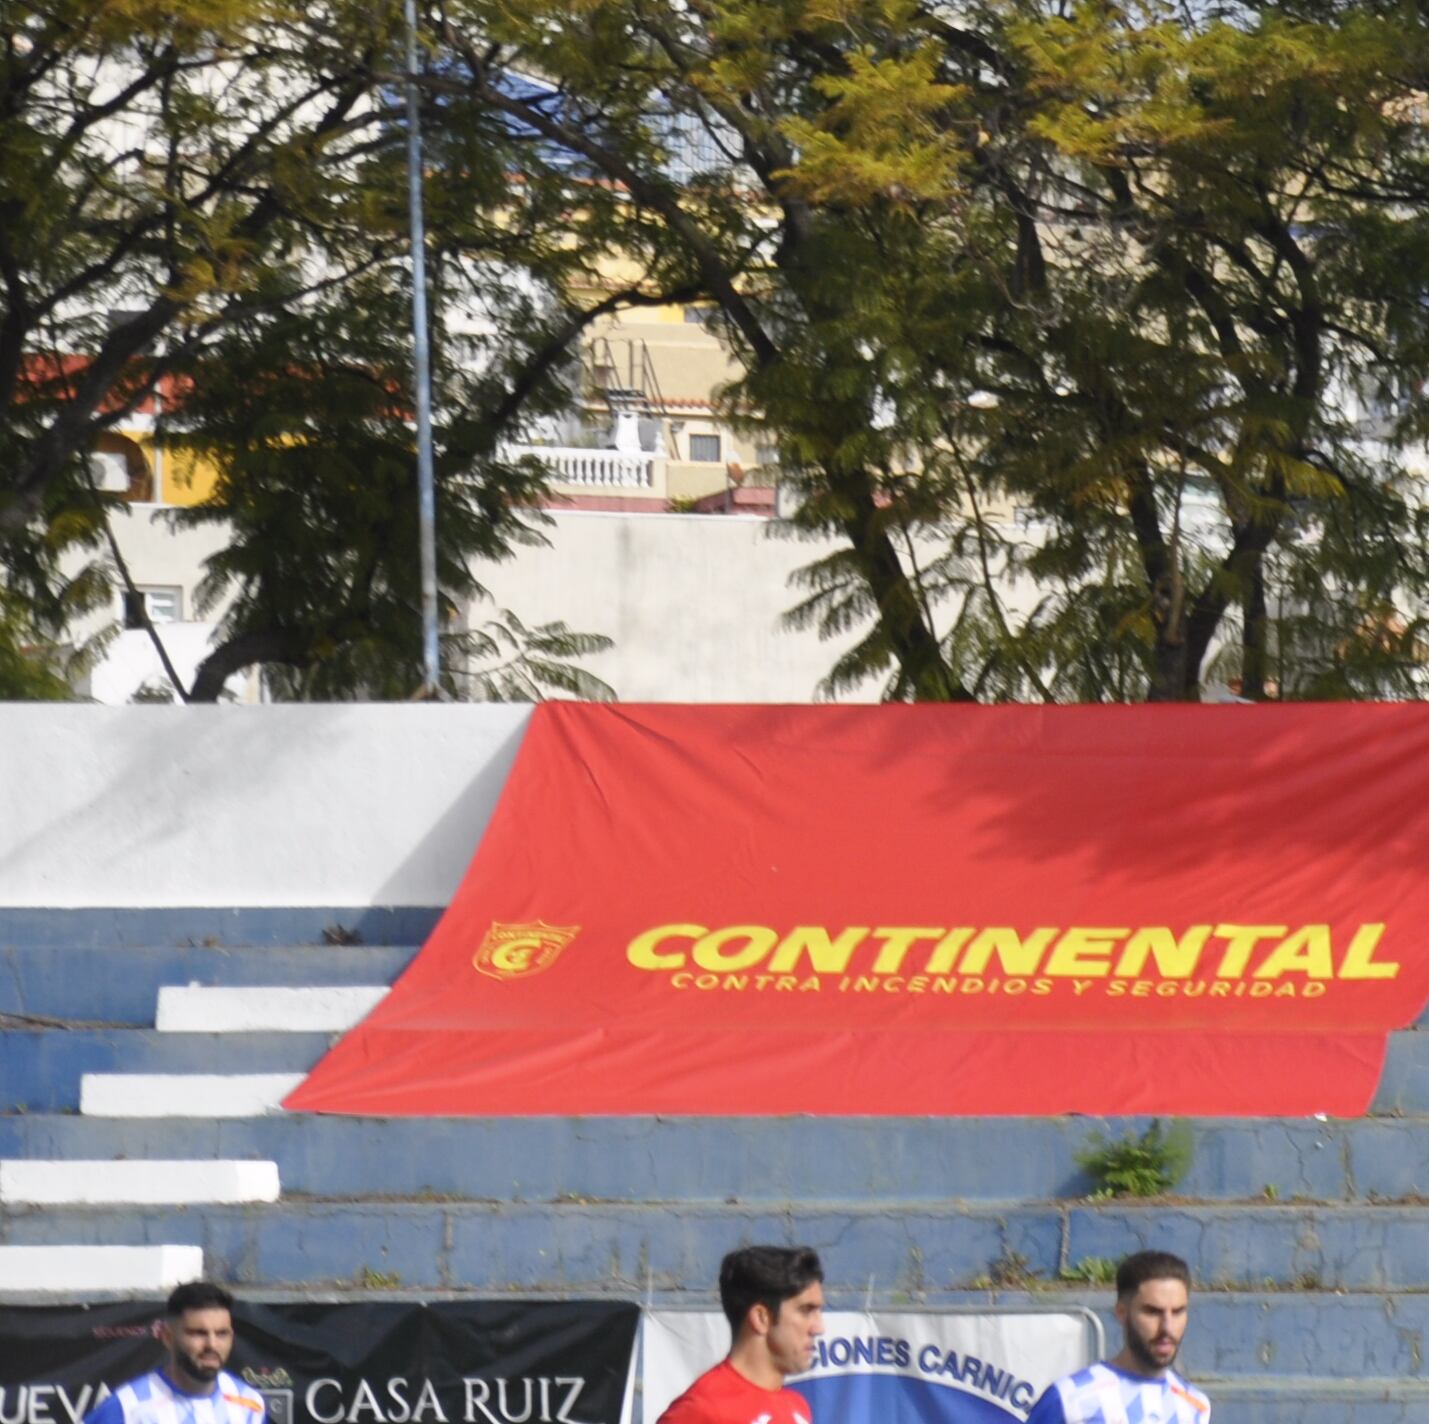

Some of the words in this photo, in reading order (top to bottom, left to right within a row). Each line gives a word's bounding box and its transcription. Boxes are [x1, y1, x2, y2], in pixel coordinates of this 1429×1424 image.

[626, 922, 1400, 980] CONTINENTAL
[671, 972, 821, 993] CONTRA
[838, 975, 1053, 997] INCENDIOS
[1073, 980, 1092, 997] Y
[1106, 979, 1327, 999] SEGURIDAD
[305, 1377, 449, 1424] CASA
[918, 1344, 1032, 1414] CARNIC
